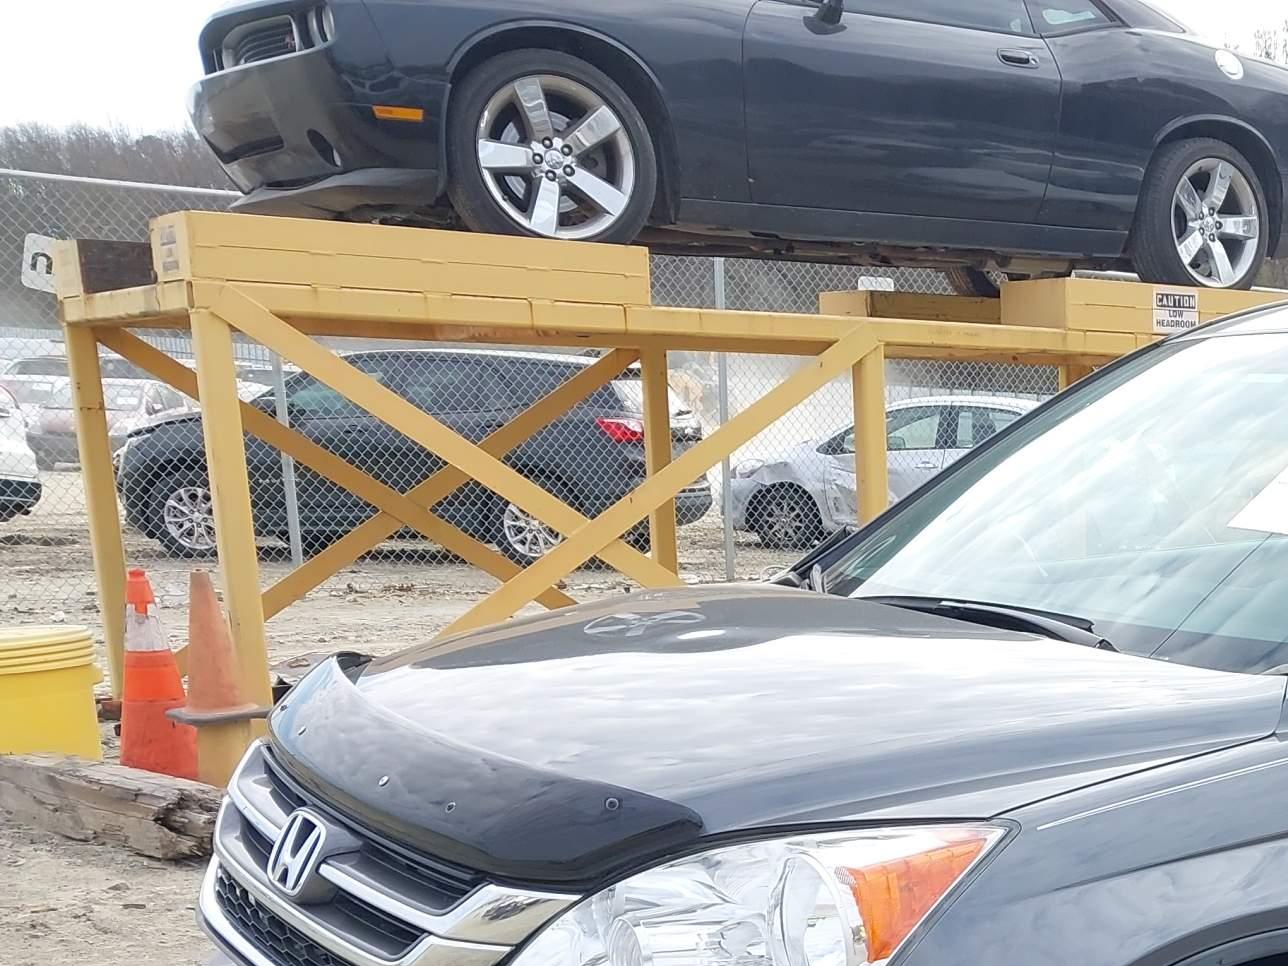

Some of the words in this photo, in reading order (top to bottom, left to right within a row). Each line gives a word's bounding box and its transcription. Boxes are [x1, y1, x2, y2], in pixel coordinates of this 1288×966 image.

[1156, 295, 1195, 307] CAUTION
[1168, 310, 1184, 318] LOW
[1156, 319, 1196, 328] HEADROOM
